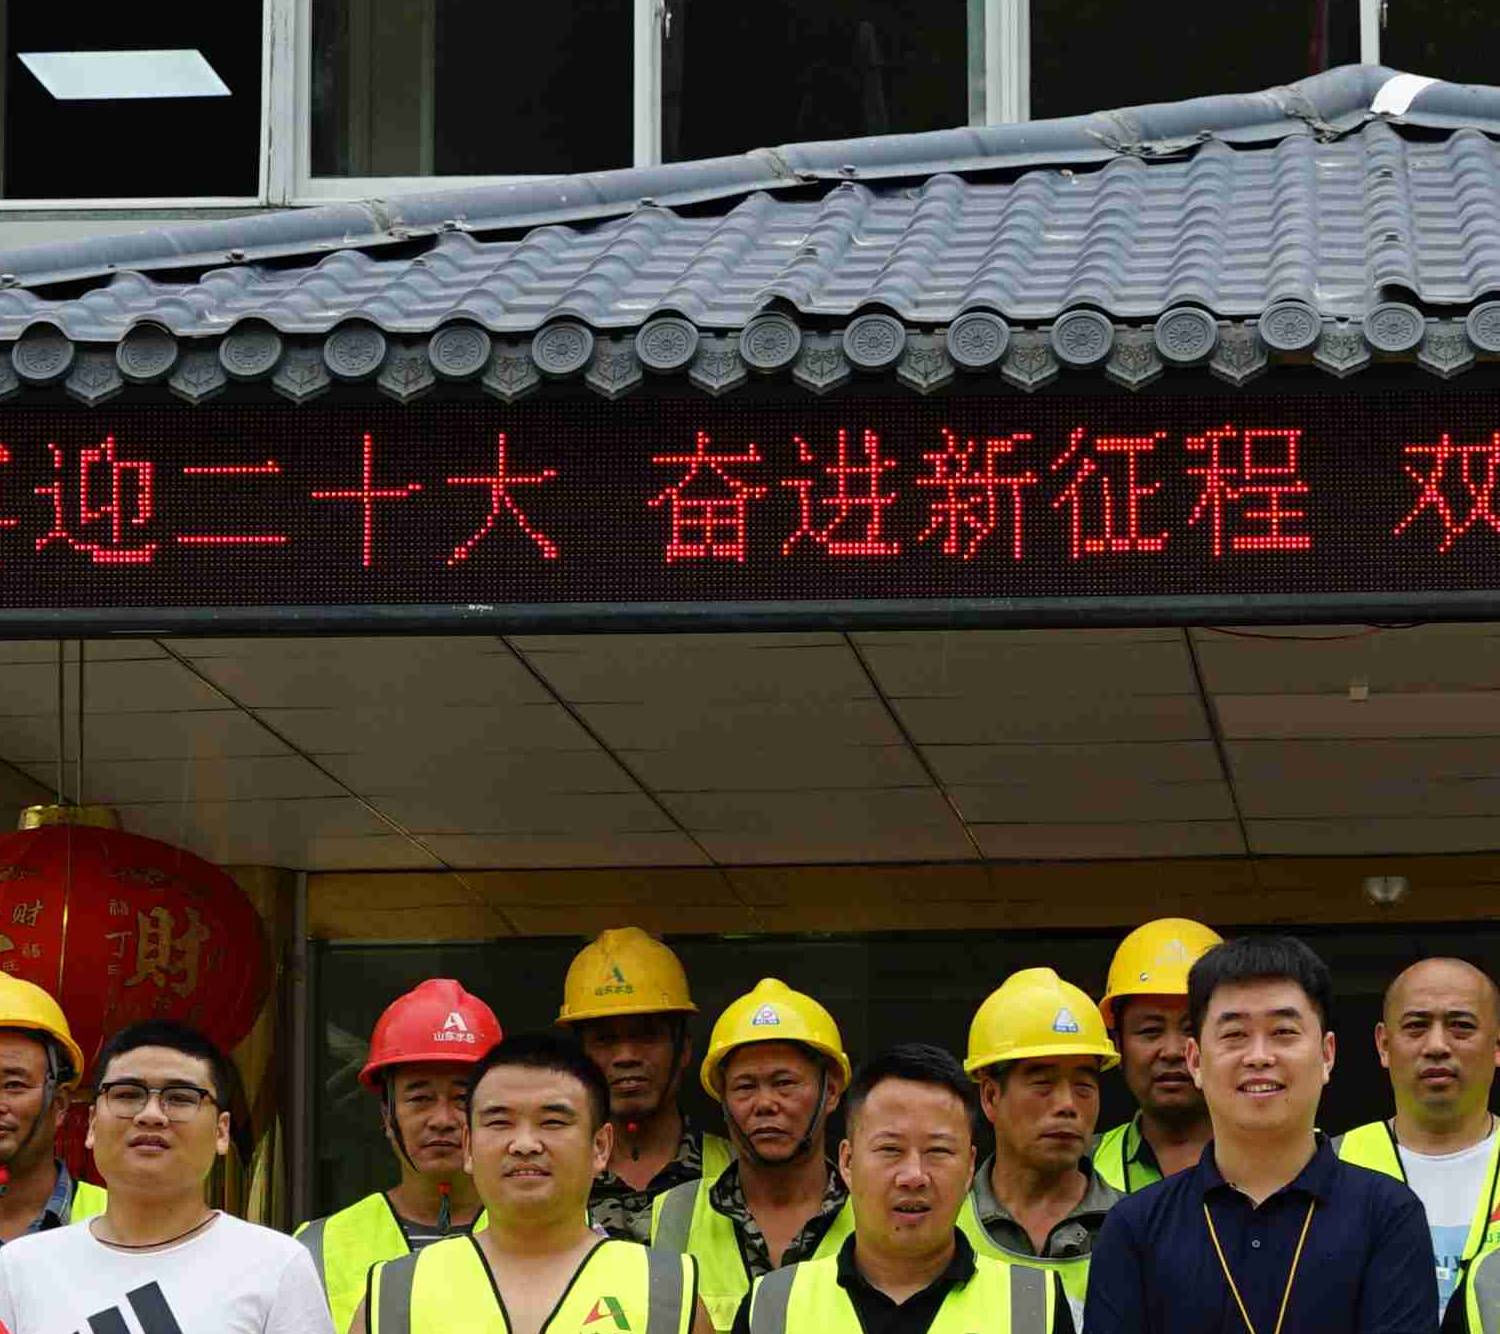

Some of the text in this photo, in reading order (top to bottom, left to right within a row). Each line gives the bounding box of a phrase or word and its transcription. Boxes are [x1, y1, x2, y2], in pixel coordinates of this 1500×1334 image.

[648, 427, 1313, 564] 奋进新征程
[124, 905, 211, 998] 財
